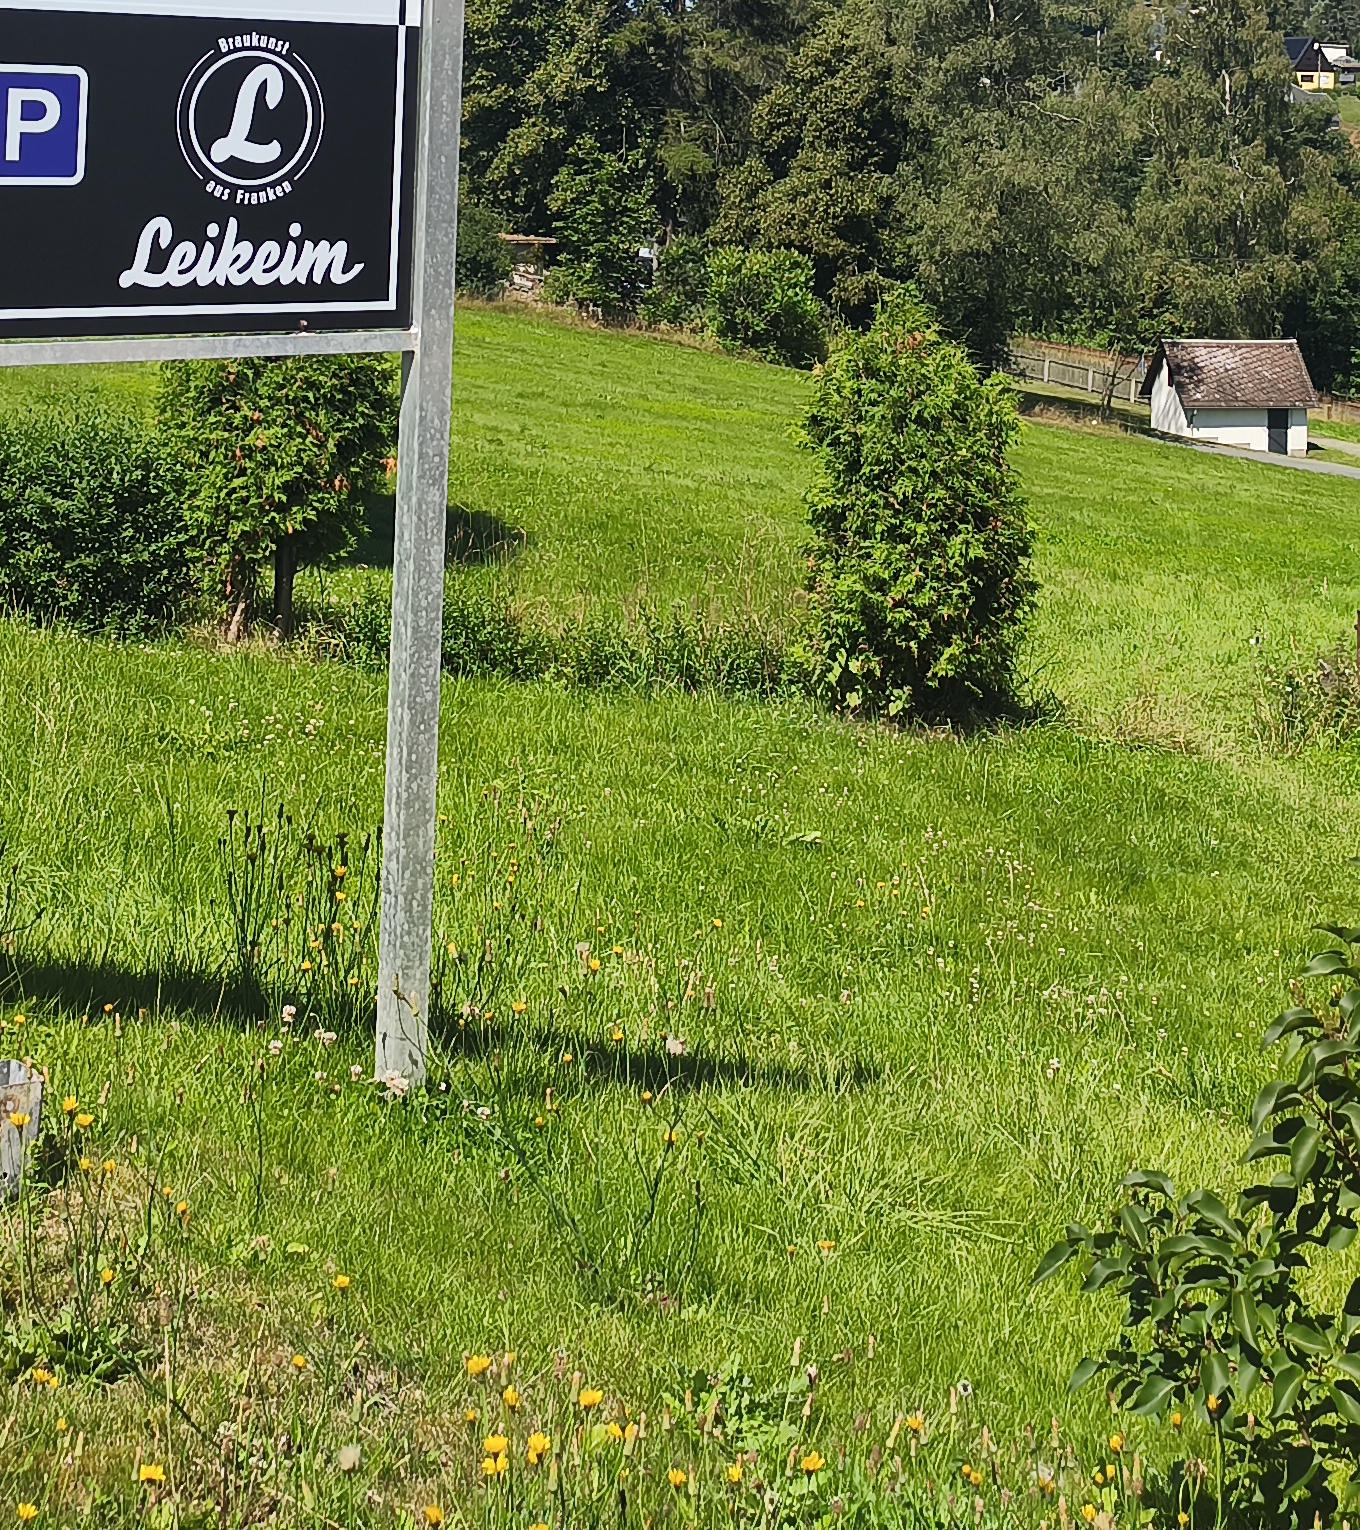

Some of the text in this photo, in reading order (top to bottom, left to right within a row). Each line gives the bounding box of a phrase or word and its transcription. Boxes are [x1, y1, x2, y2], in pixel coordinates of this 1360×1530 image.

[217, 31, 290, 55] Braukunst
[5, 87, 61, 162] P
[209, 63, 284, 164] L
[205, 180, 293, 205] aus Franken
[118, 216, 365, 289] Leikeim
